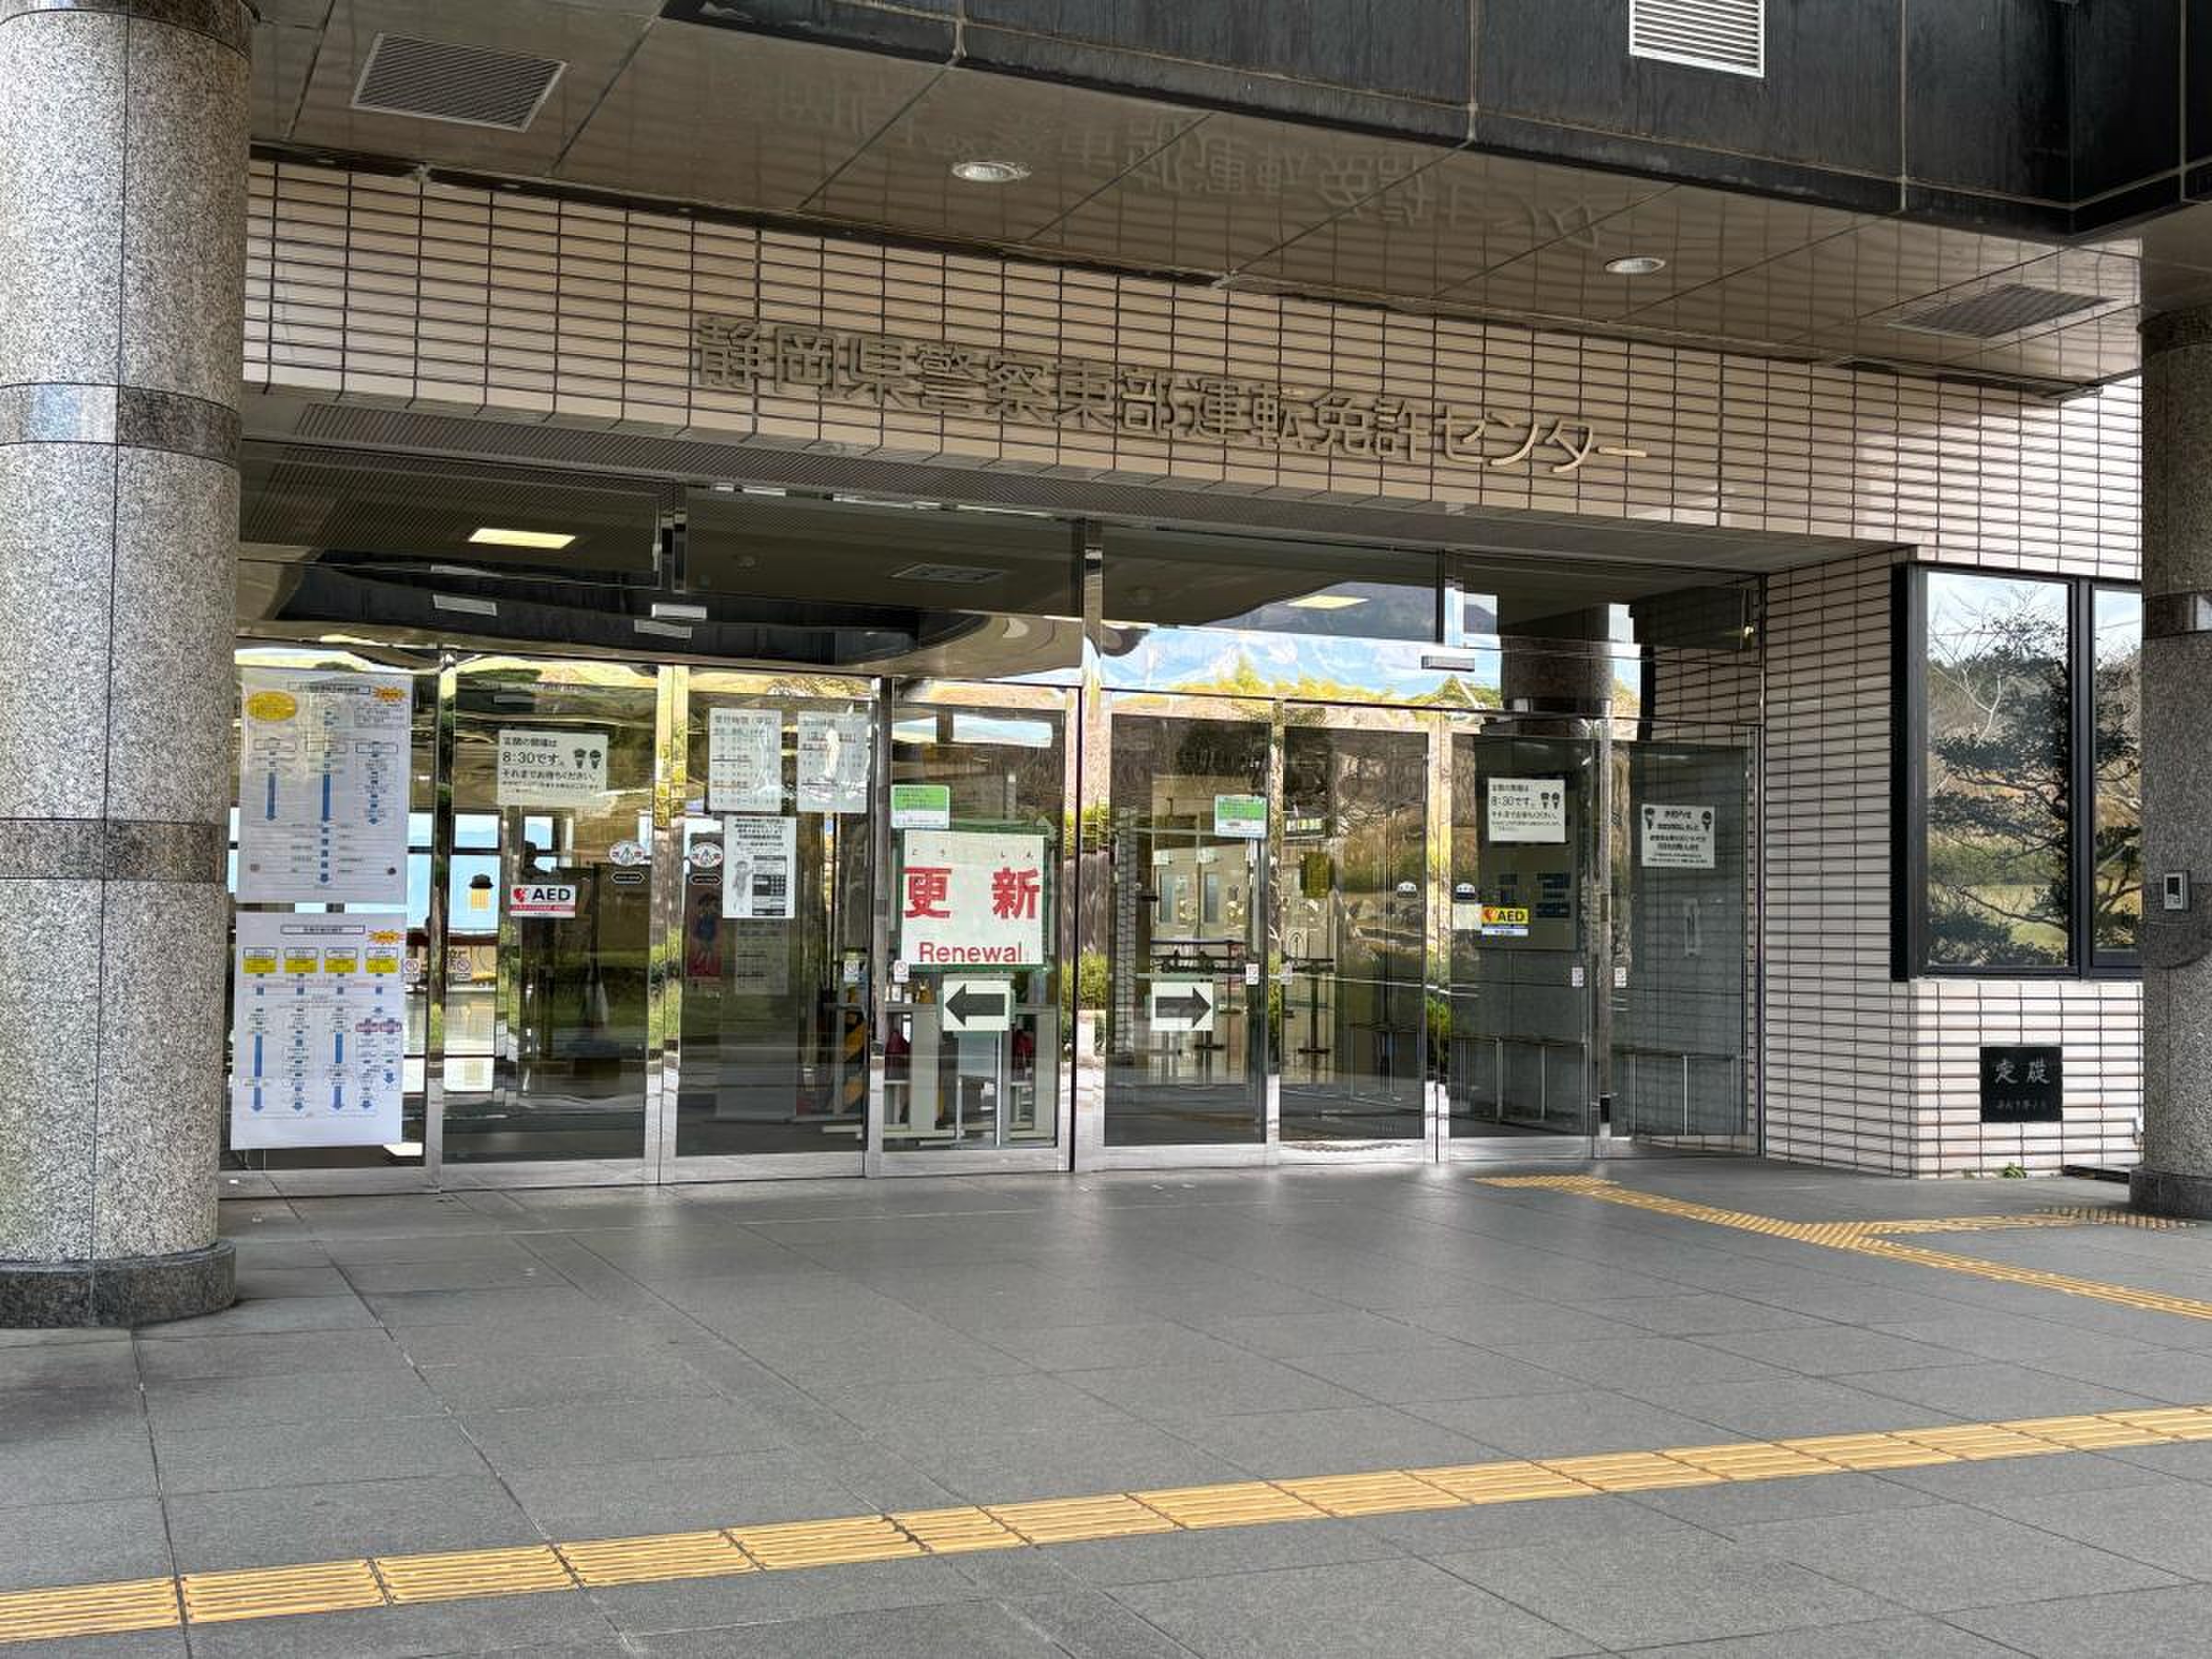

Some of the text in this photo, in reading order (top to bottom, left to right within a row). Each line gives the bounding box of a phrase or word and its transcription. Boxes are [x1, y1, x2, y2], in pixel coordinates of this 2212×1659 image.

[693, 313, 1648, 476] 静岡県警察東部運転免許センター
[532, 888, 571, 900] AED
[1497, 910, 1525, 922] AED
[919, 942, 1022, 963] Renewal
